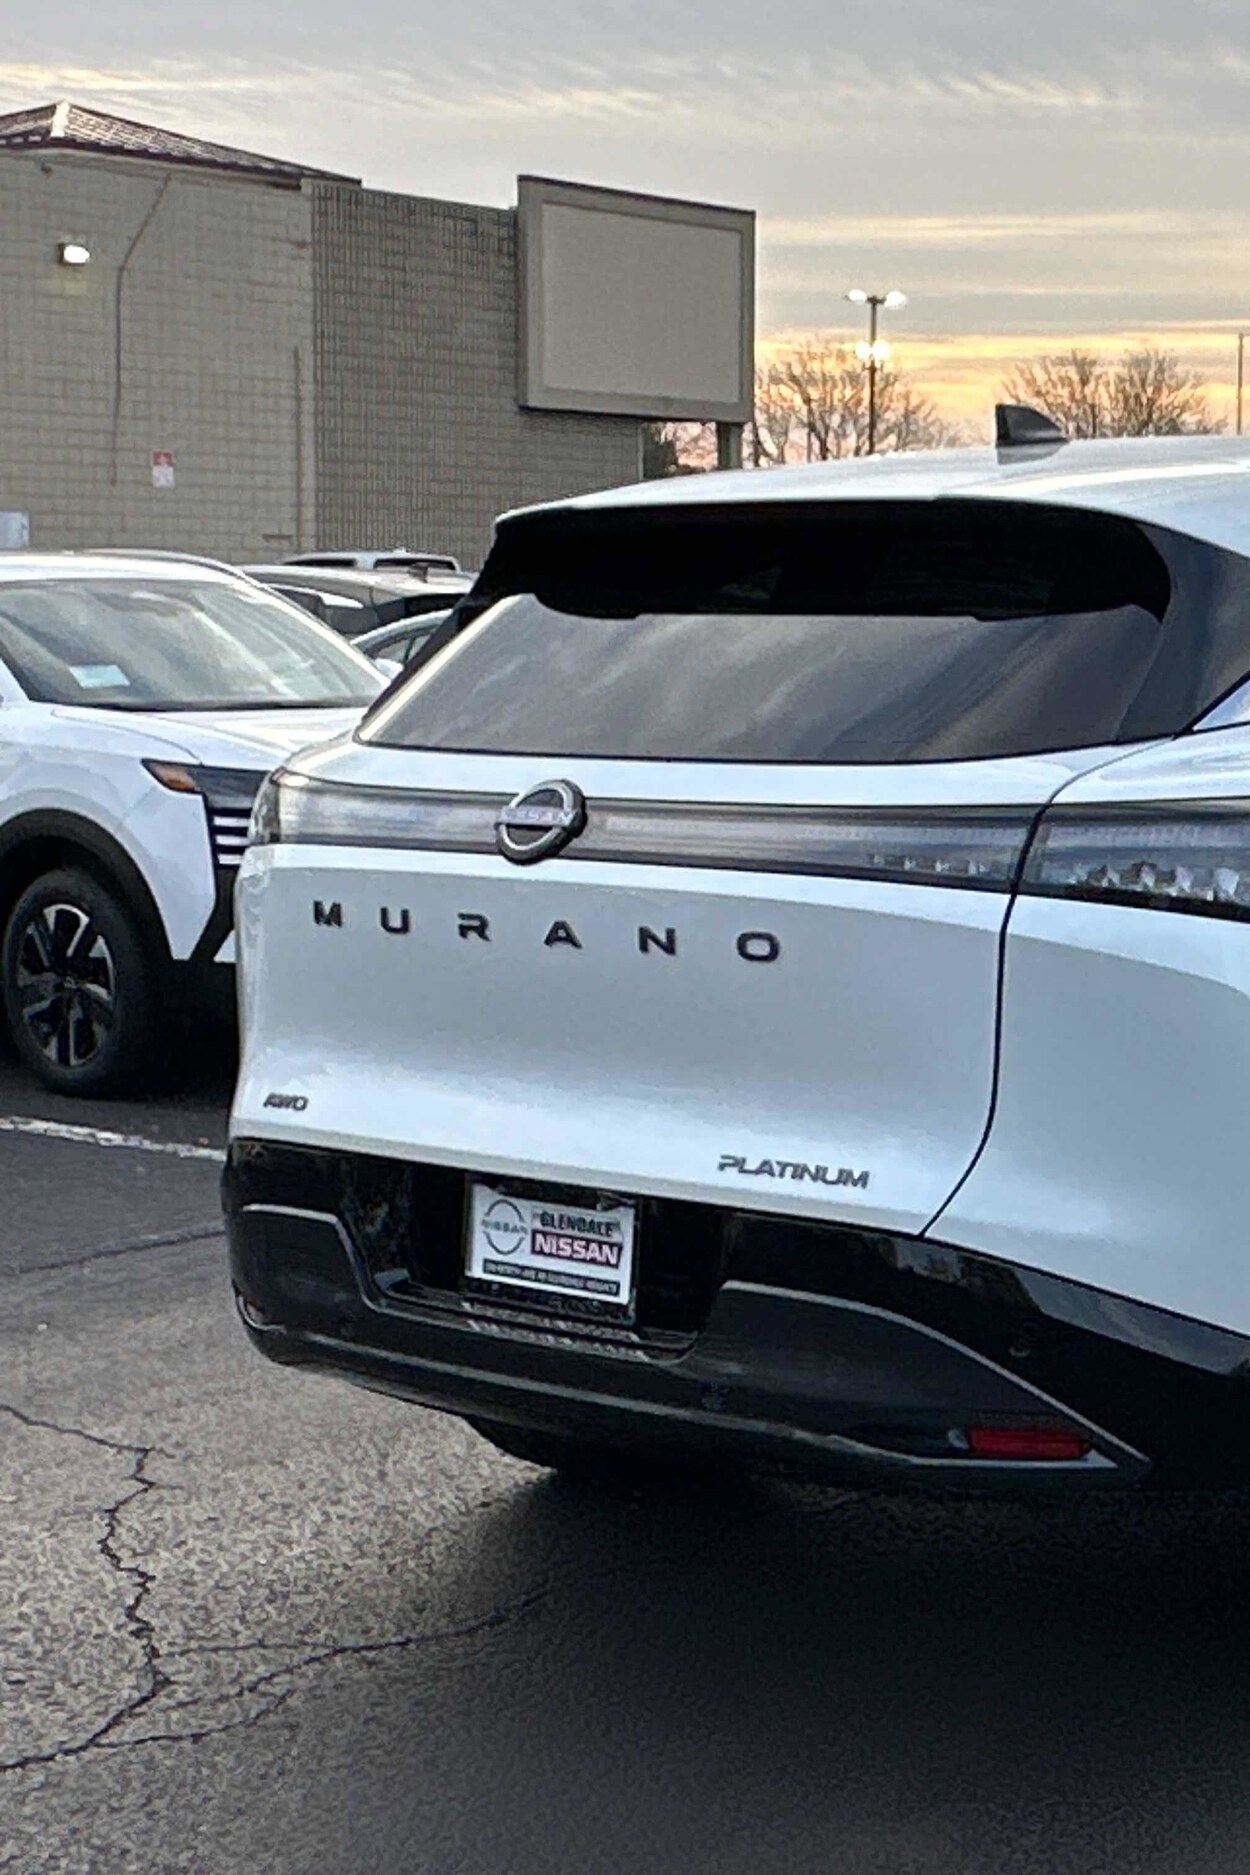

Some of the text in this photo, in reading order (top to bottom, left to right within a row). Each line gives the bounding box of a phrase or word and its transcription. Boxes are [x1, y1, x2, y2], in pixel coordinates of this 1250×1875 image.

[312, 900, 782, 963] MURANO
[718, 1154, 870, 1189] PLATINUM
[539, 1210, 615, 1237] GLENDALE
[534, 1234, 618, 1265] NISSAN
